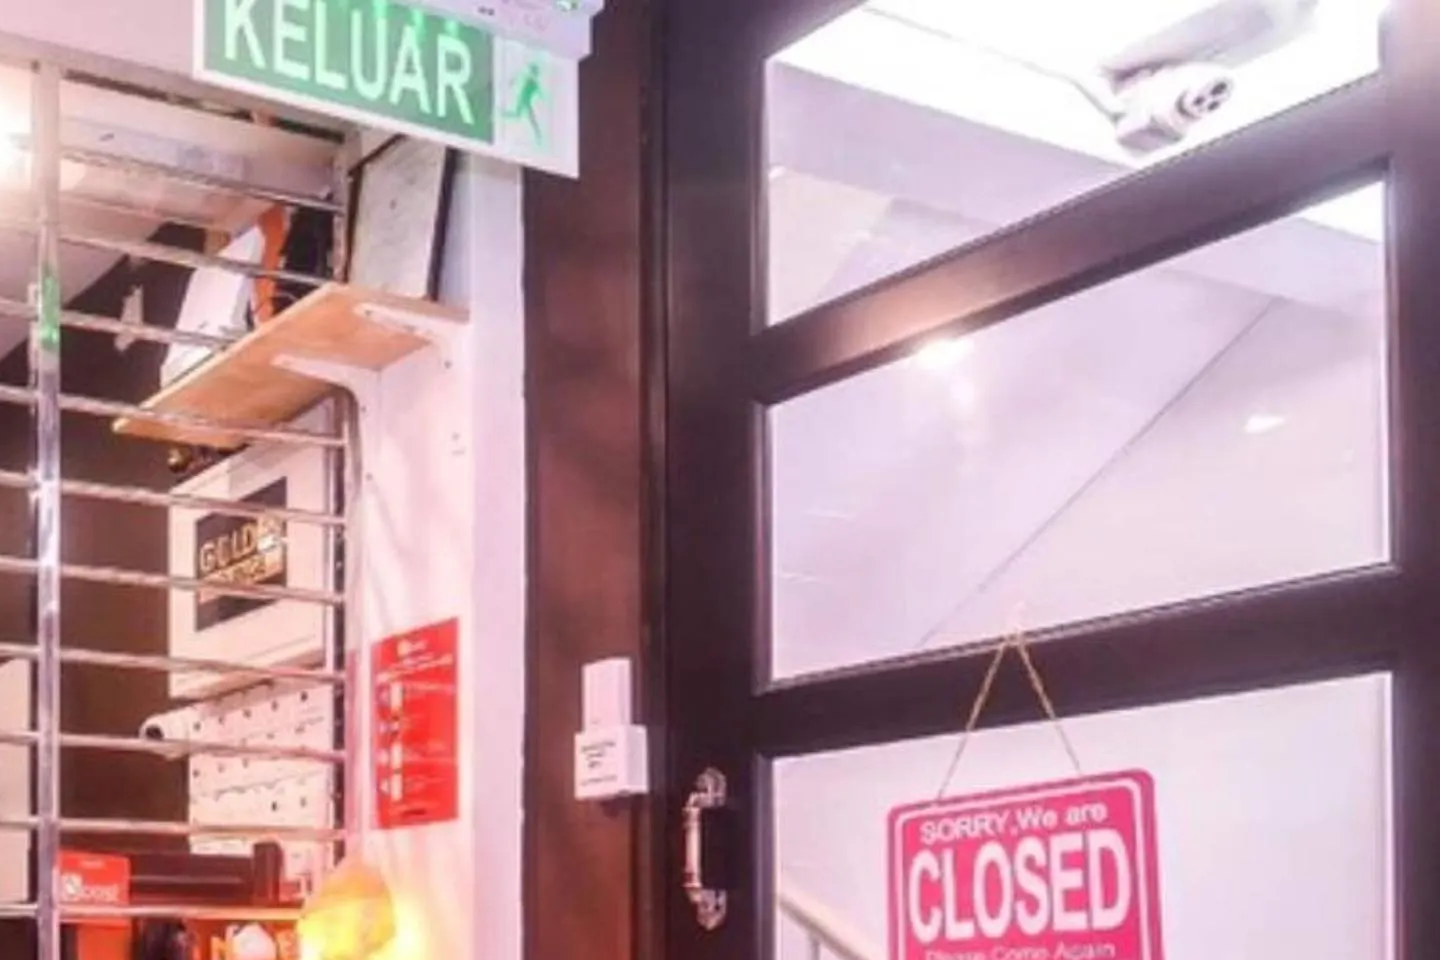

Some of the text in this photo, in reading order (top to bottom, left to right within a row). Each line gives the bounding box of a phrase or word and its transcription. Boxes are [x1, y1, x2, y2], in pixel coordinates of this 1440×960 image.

[224, 0, 474, 125] KELUAR
[201, 514, 282, 574] GOLD
[1065, 802, 1108, 826] are
[910, 828, 1131, 943] CLOSED
